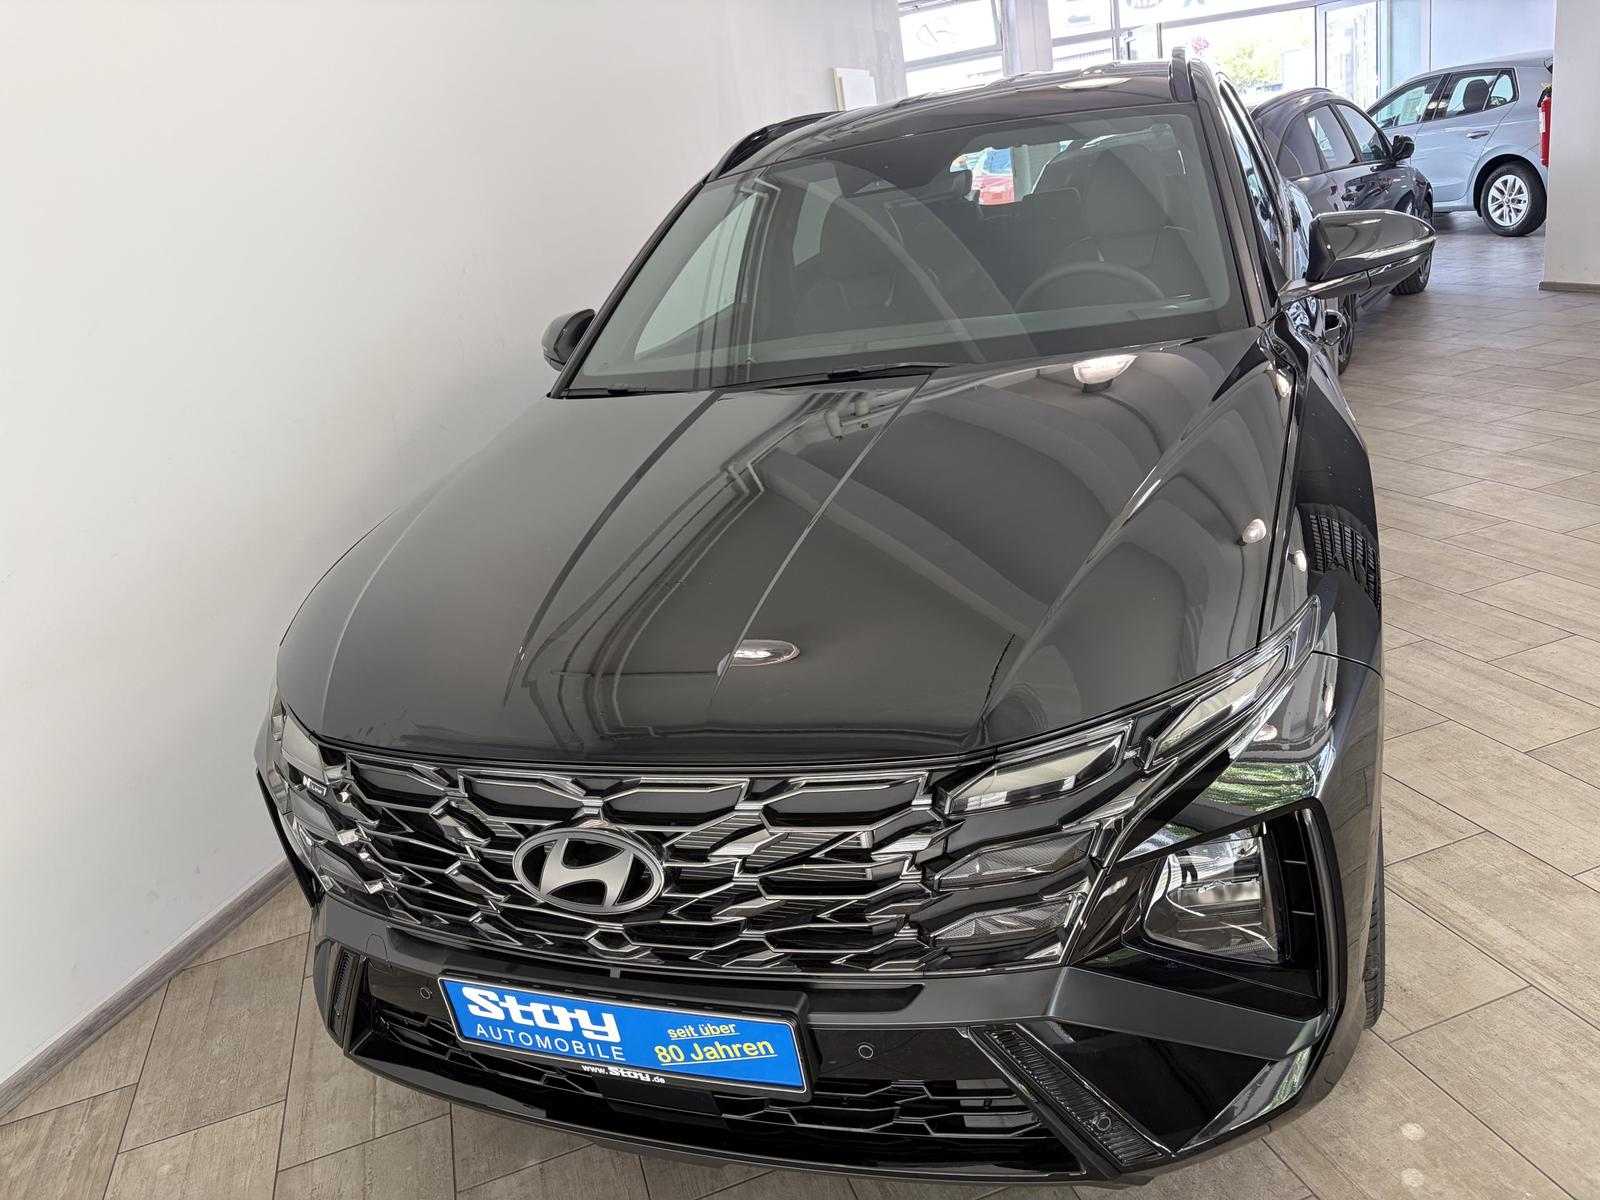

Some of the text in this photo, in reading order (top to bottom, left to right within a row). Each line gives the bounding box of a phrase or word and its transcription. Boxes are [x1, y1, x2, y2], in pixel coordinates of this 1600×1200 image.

[462, 986, 622, 1043] Stoy
[476, 1023, 627, 1062] AUTOMOBILE
[667, 1022, 737, 1039] seit über
[654, 1040, 776, 1064] 80 Jahren
